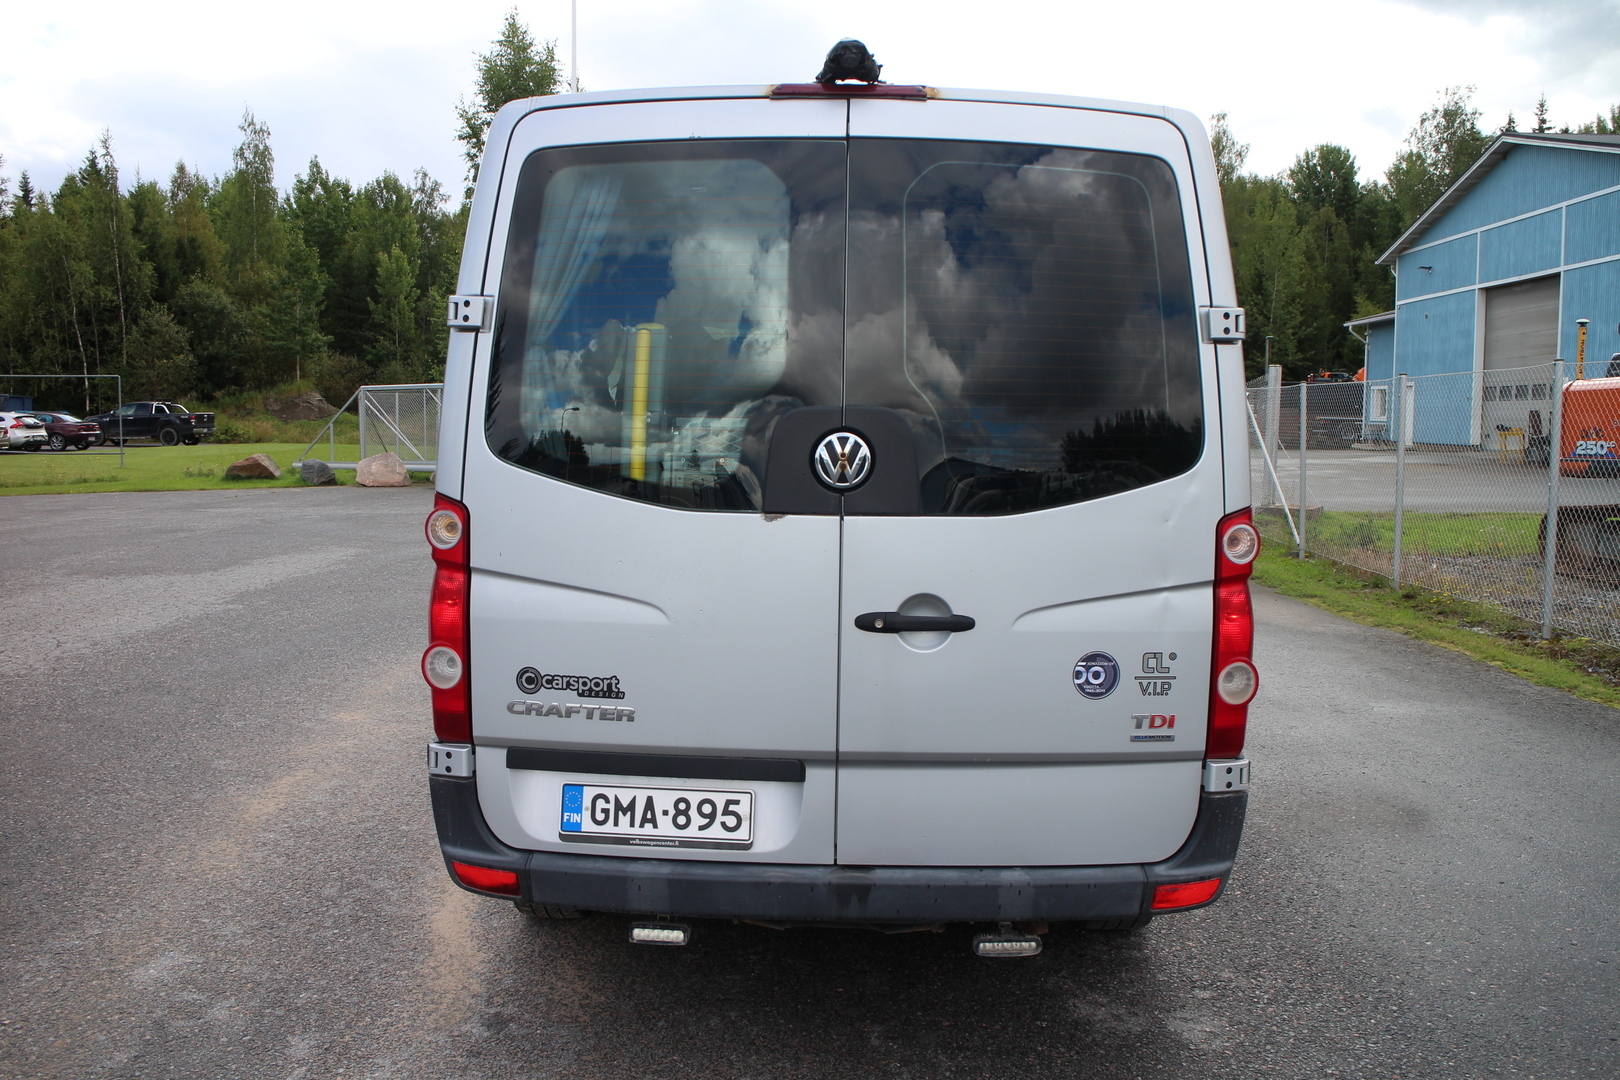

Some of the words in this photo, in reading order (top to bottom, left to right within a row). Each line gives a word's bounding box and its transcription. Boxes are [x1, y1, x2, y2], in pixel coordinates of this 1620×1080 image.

[542, 674, 619, 694] carsport
[584, 691, 625, 699] DESIGN
[506, 700, 636, 722] CRAFTER
[1131, 714, 1177, 729] TDI
[563, 812, 582, 824] FIN
[589, 793, 743, 833] GMA-895
